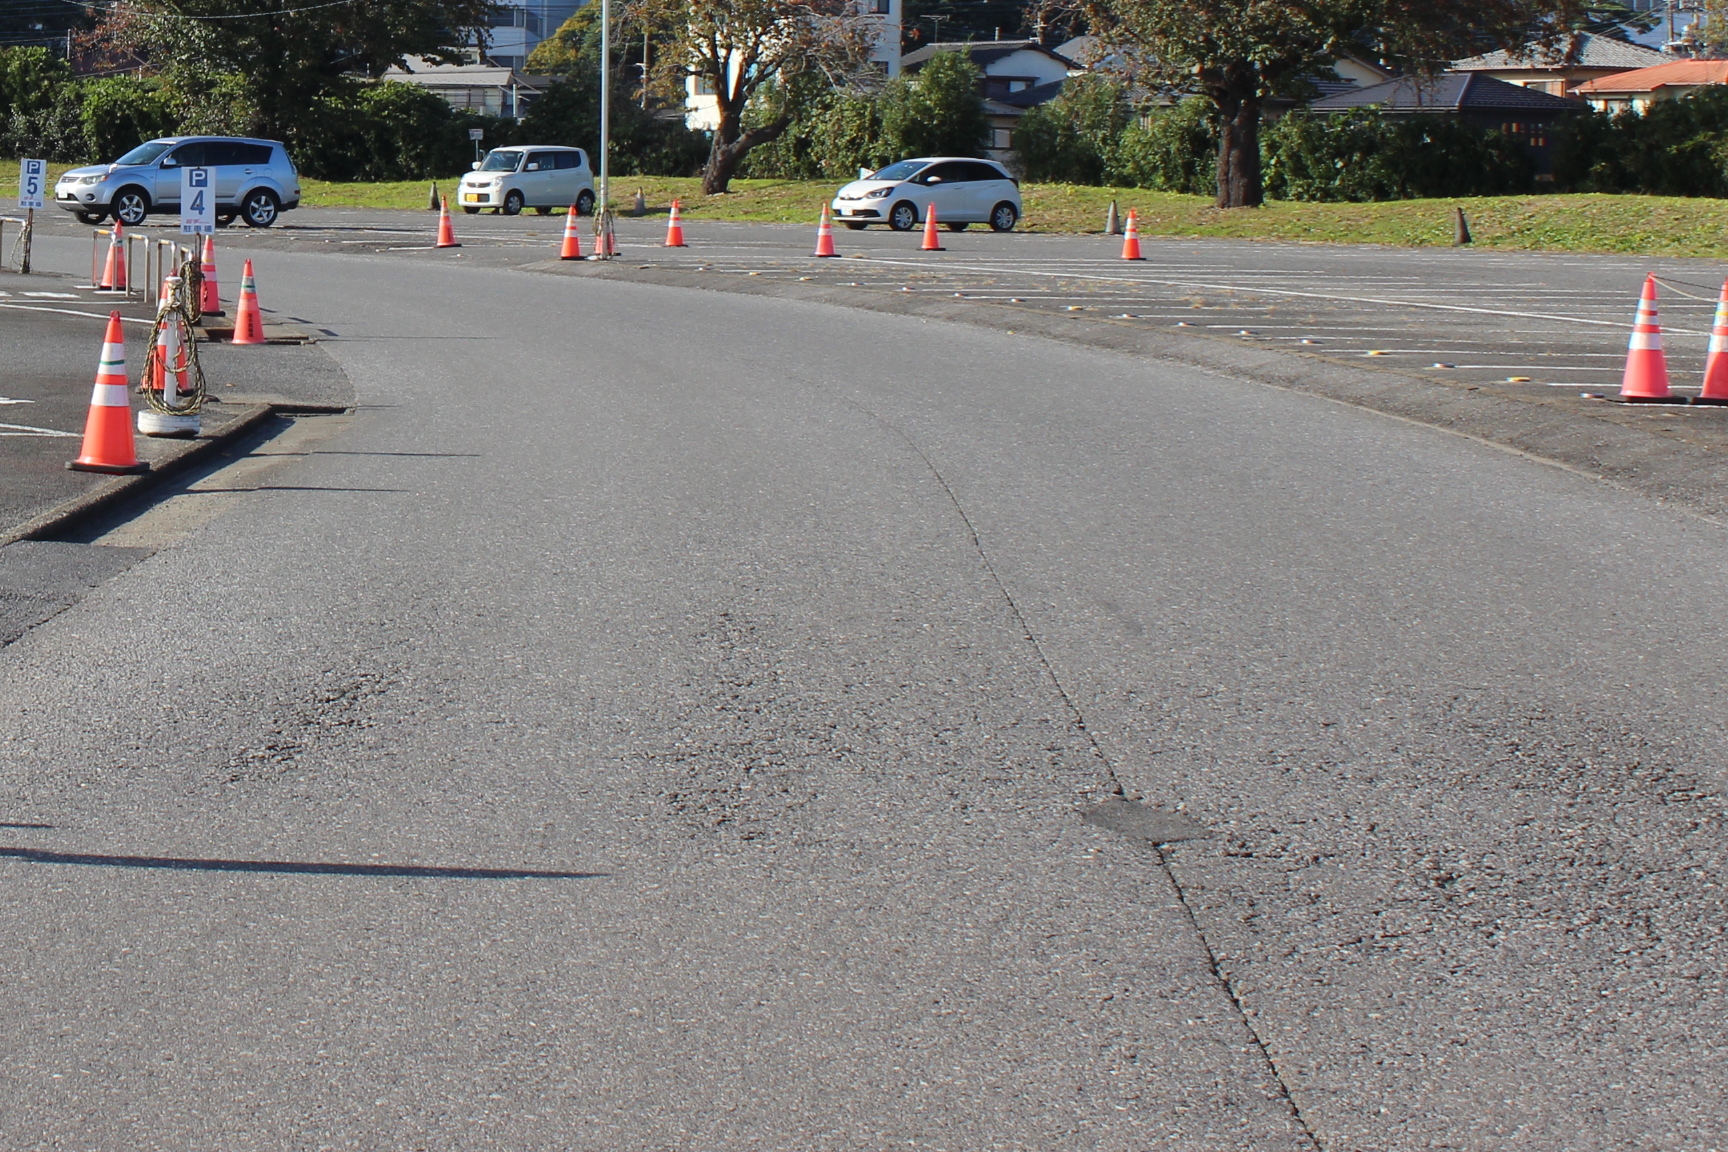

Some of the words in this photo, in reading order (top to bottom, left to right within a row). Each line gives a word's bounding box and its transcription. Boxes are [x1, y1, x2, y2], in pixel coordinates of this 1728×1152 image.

[28, 161, 39, 173] P
[27, 176, 38, 195] 5
[192, 170, 206, 186] P
[190, 190, 205, 215] 4
